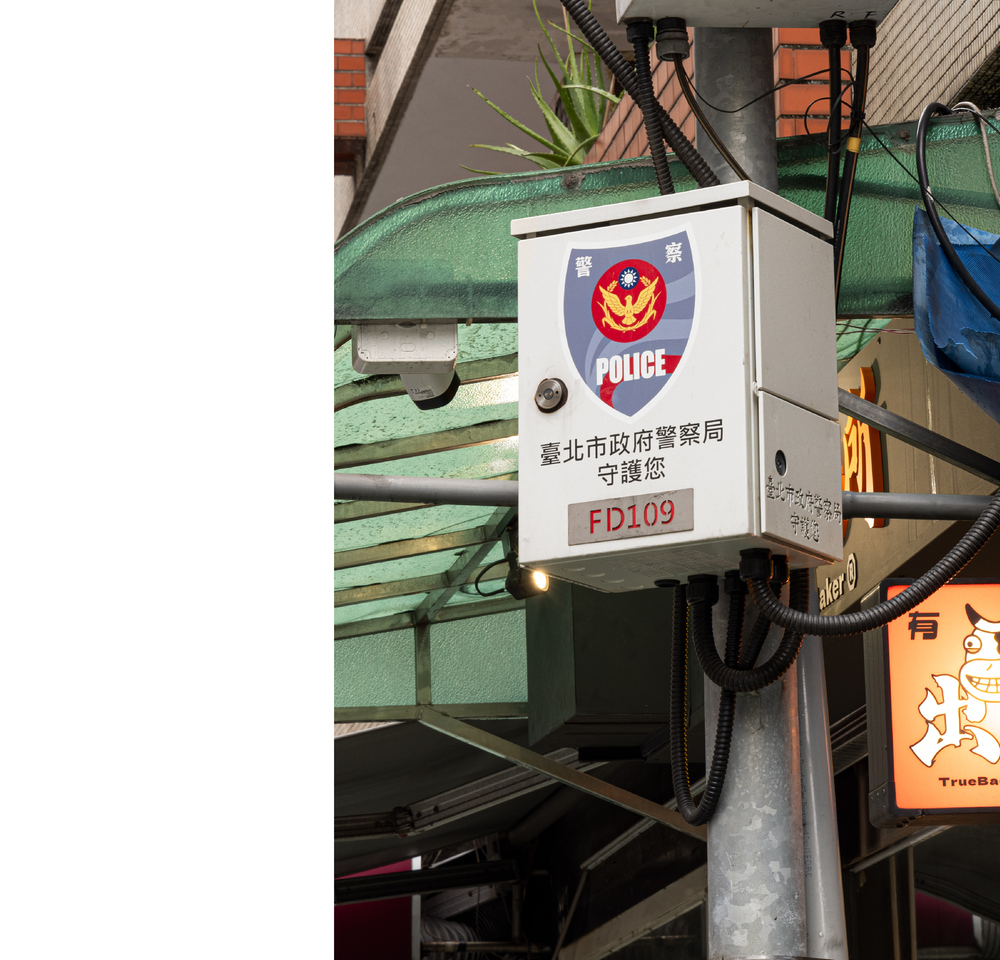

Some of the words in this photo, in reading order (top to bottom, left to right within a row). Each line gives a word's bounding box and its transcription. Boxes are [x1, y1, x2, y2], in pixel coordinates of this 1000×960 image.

[830, 10, 845, 19] R
[575, 256, 593, 278] 警
[664, 241, 683, 264] 察
[596, 348, 667, 386] POLICE
[540, 418, 724, 467] 臺北市政府警察局
[597, 456, 666, 487] 守護您
[588, 499, 676, 534] FD109
[819, 572, 845, 610] aker
[908, 610, 940, 640] 有
